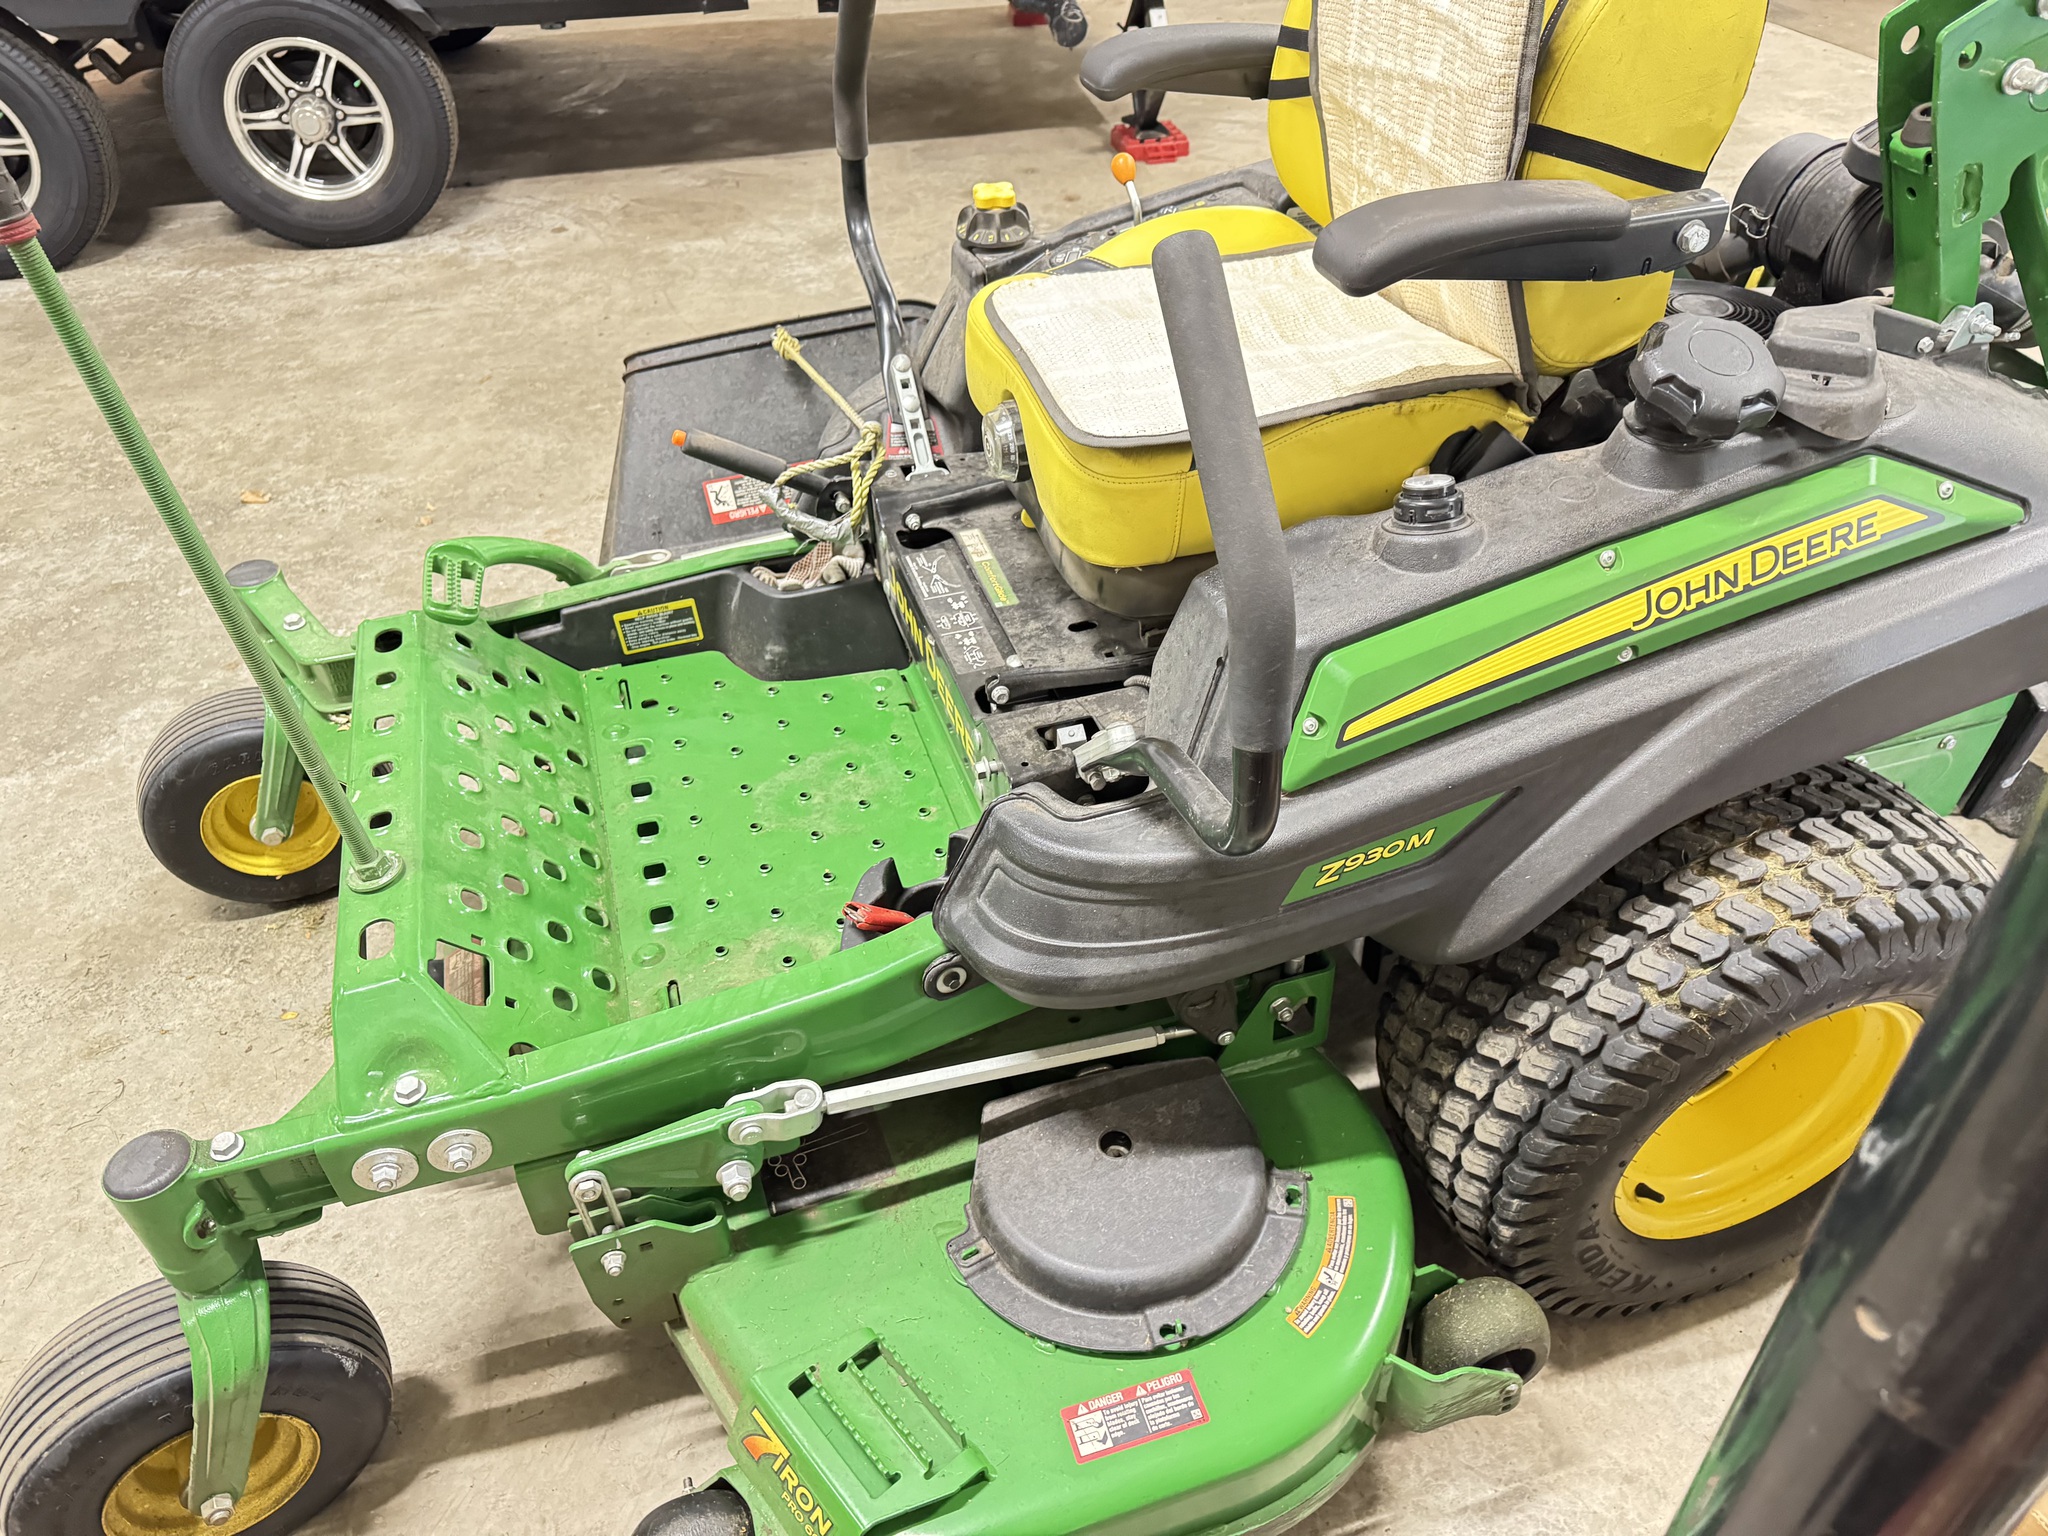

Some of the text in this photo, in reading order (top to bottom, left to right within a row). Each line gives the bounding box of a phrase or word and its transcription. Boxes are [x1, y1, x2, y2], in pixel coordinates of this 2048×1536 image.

[1633, 511, 1878, 627] JOHN DEERE
[643, 605, 669, 615] CAUTION
[889, 566, 975, 767] JOHN DEERE
[1314, 827, 1437, 888] Z930M
[1577, 1218, 1656, 1294] KENDA
[1088, 1392, 1124, 1410] DANGER
[1146, 1372, 1183, 1391] PELIGRO
[781, 1491, 818, 1536] PRO 6
